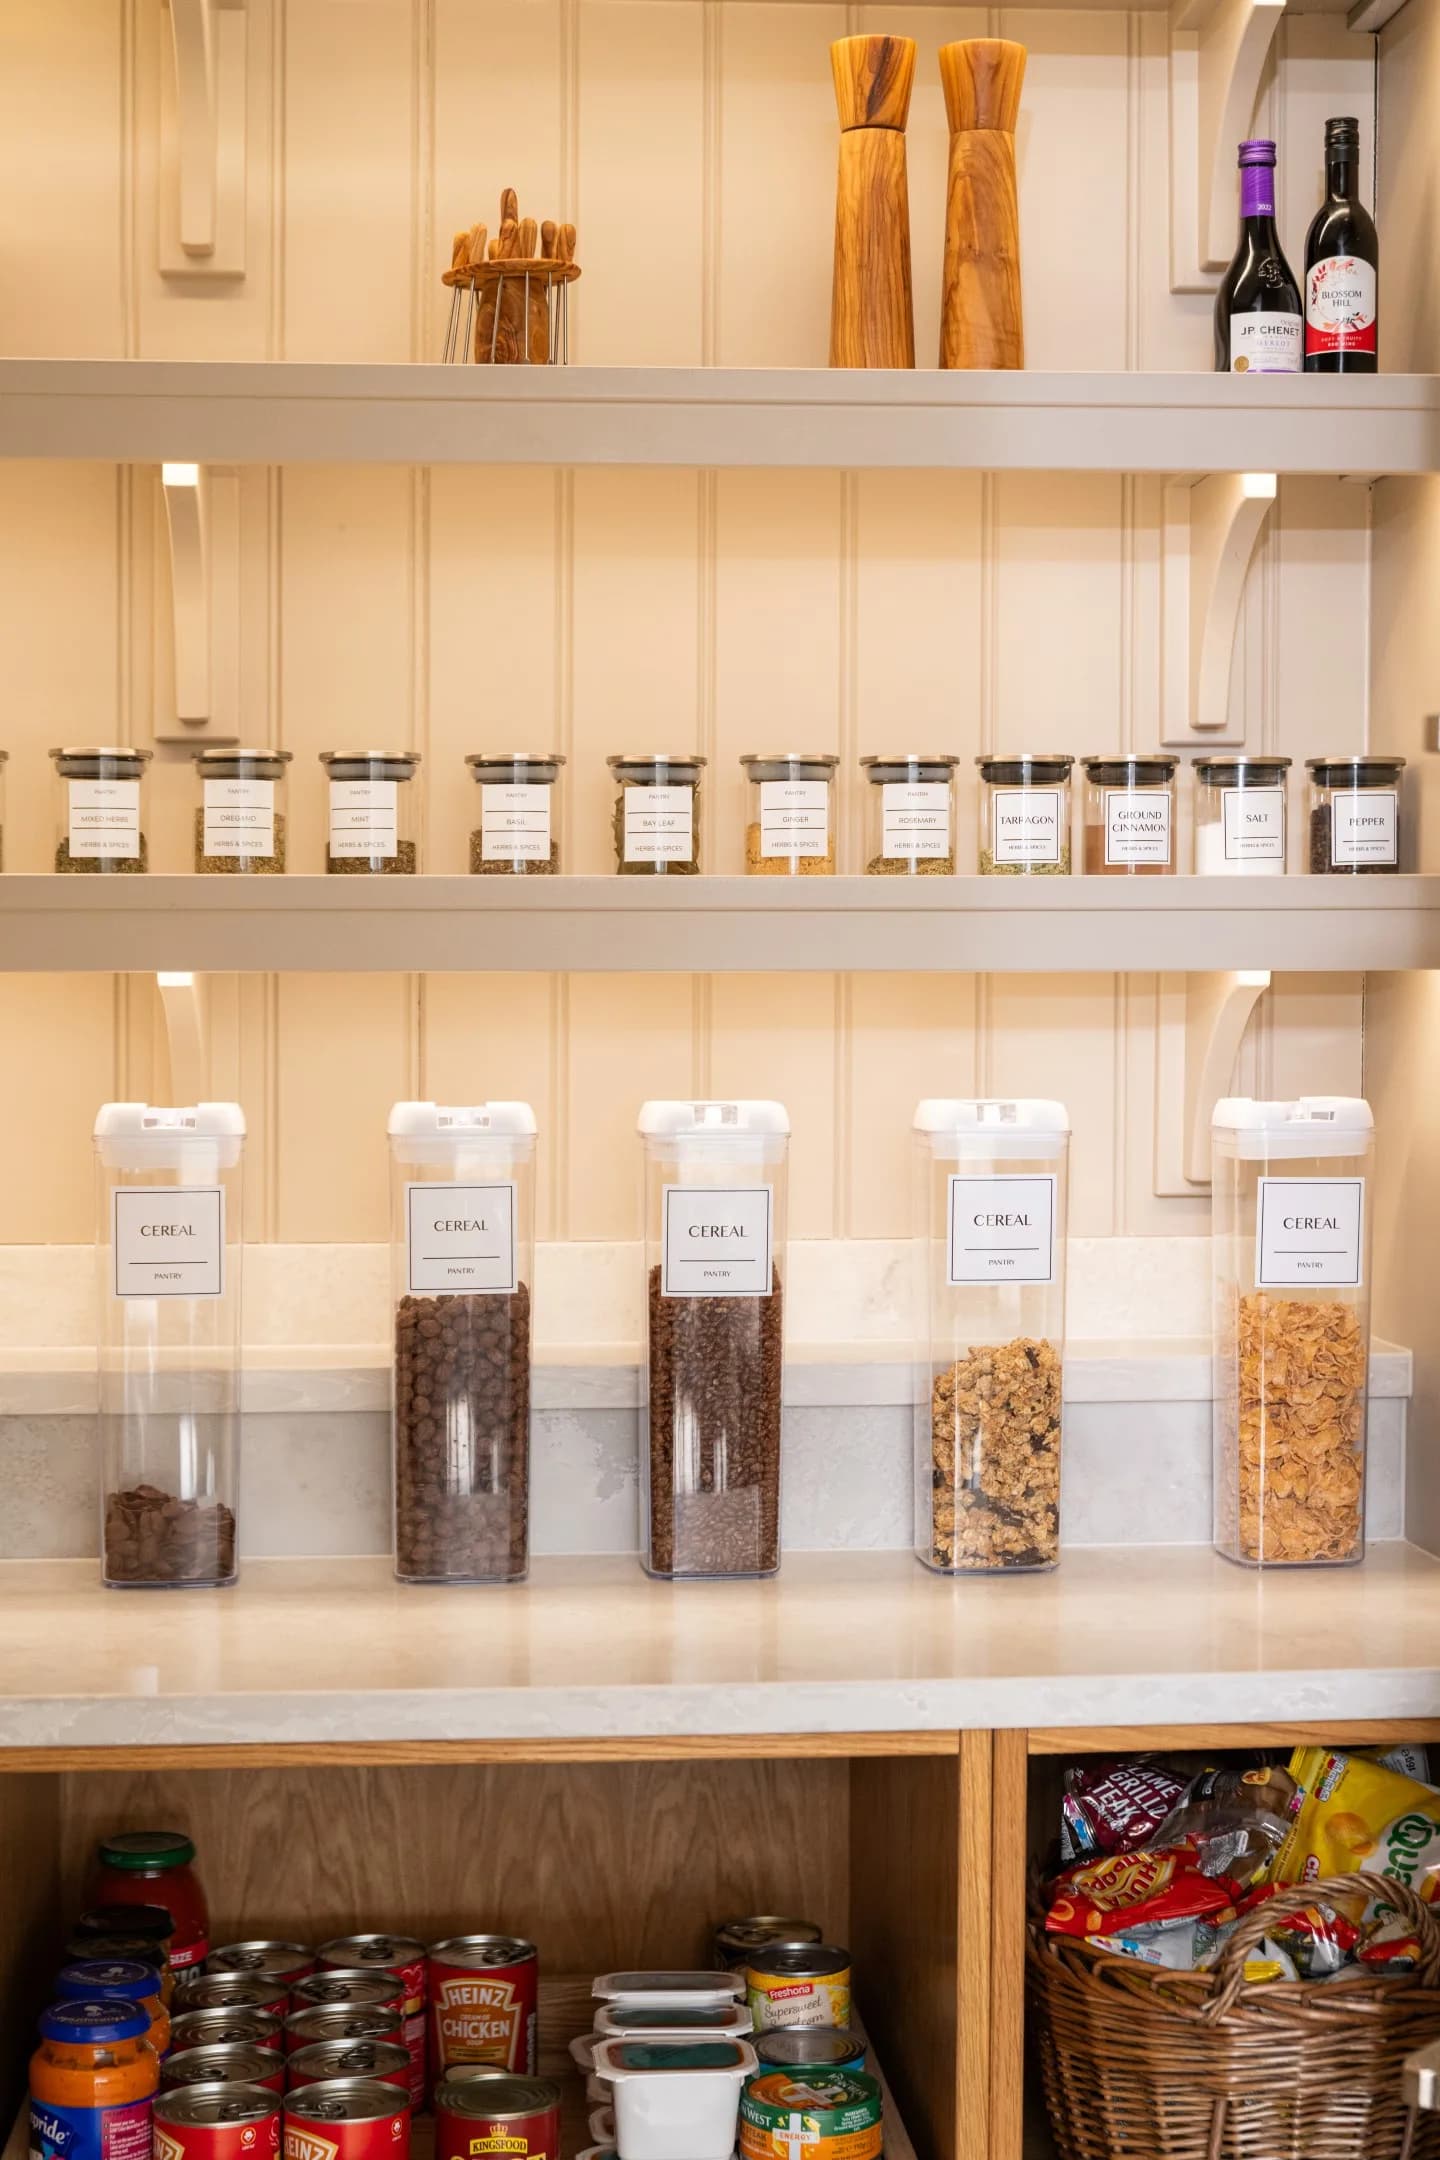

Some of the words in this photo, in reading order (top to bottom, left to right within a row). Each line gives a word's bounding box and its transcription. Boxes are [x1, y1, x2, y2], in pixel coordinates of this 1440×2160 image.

[1321, 290, 1362, 299] BLOSSOM
[1332, 299, 1353, 307] HILL
[1260, 326, 1300, 336] CHENET
[80, 815, 105, 823] MIXED
[351, 815, 369, 823] MINT
[1118, 811, 1162, 820] GROUND
[1246, 814, 1268, 823] SALT
[506, 818, 526, 826] BASIL
[642, 819, 656, 827] BAY
[657, 819, 675, 827] LEAF
[1000, 816, 1054, 825] TARRAGON
[1349, 817, 1385, 826] PEPPER
[1112, 823, 1166, 832] CINNAMON
[973, 1214, 1032, 1227] CEREAL
[1283, 1217, 1341, 1230] CEREAL
[433, 1219, 489, 1232] CEREAL
[140, 1224, 197, 1237] CEREAL
[688, 1225, 751, 1238] CEREAL
[447, 1267, 476, 1275] PANTRY
[703, 1270, 732, 1278] PANTRY
[153, 1272, 183, 1280] PANTRY
[1091, 1780, 1142, 1821] TEAK
[1104, 1863, 1158, 1908] HULA
[448, 1987, 505, 2007] HEINZ
[770, 1986, 810, 1999] Freshona
[765, 1995, 822, 2020] Supersweet
[442, 2018, 510, 2039] CHICKEN
[747, 2108, 772, 2128] WEST
[779, 2132, 812, 2141] ENERGY
[473, 2140, 527, 2152] KINGSFOOD
